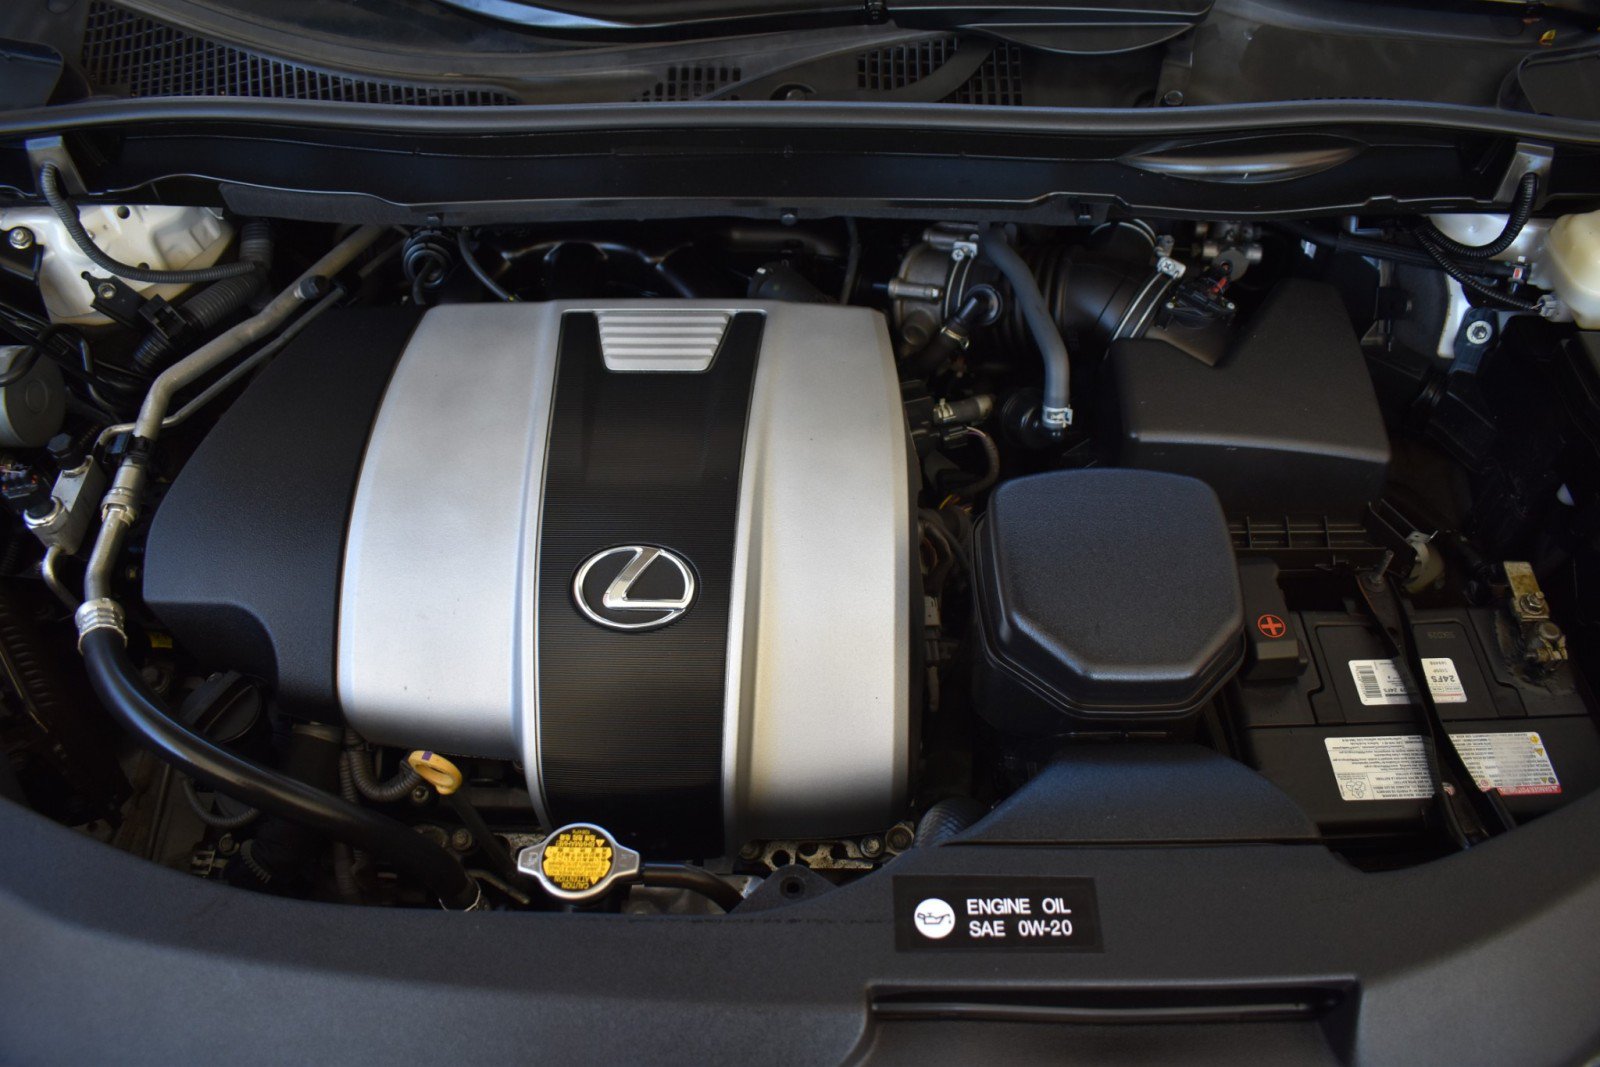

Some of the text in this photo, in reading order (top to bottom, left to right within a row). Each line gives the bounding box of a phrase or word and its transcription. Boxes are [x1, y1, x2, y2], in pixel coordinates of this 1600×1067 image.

[1430, 675, 1456, 683] 24FS
[966, 897, 1072, 915] ENGINE OIL
[969, 919, 1073, 938] SAE 0W-20
